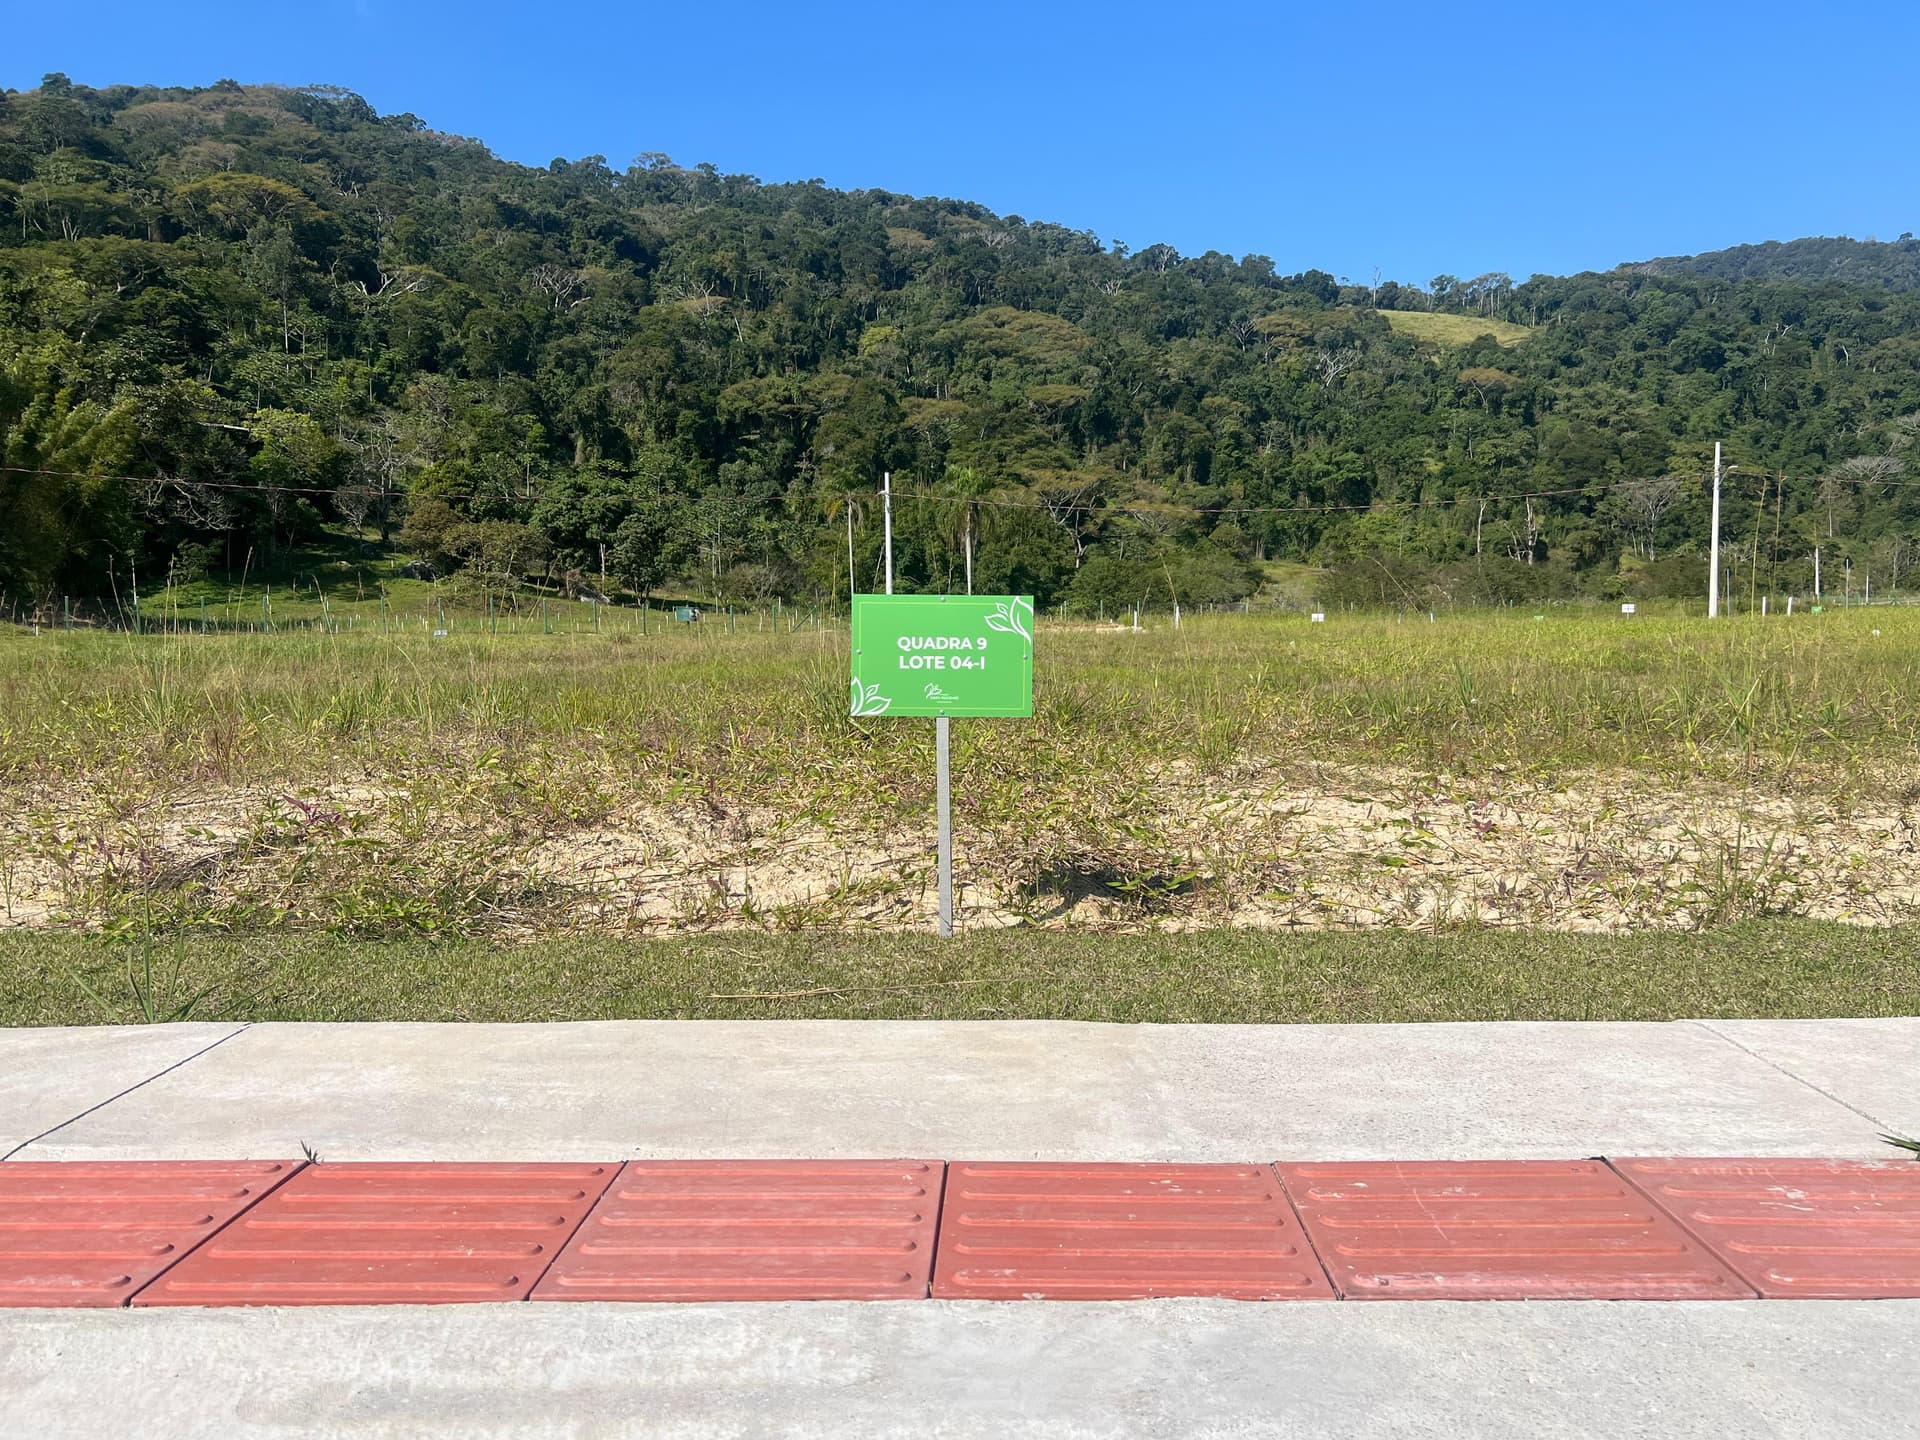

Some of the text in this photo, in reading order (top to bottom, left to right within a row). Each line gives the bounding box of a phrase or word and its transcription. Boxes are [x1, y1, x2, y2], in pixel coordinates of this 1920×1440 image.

[897, 636, 987, 651] QUADRA 9
[899, 656, 985, 670] LOTE 04-I
